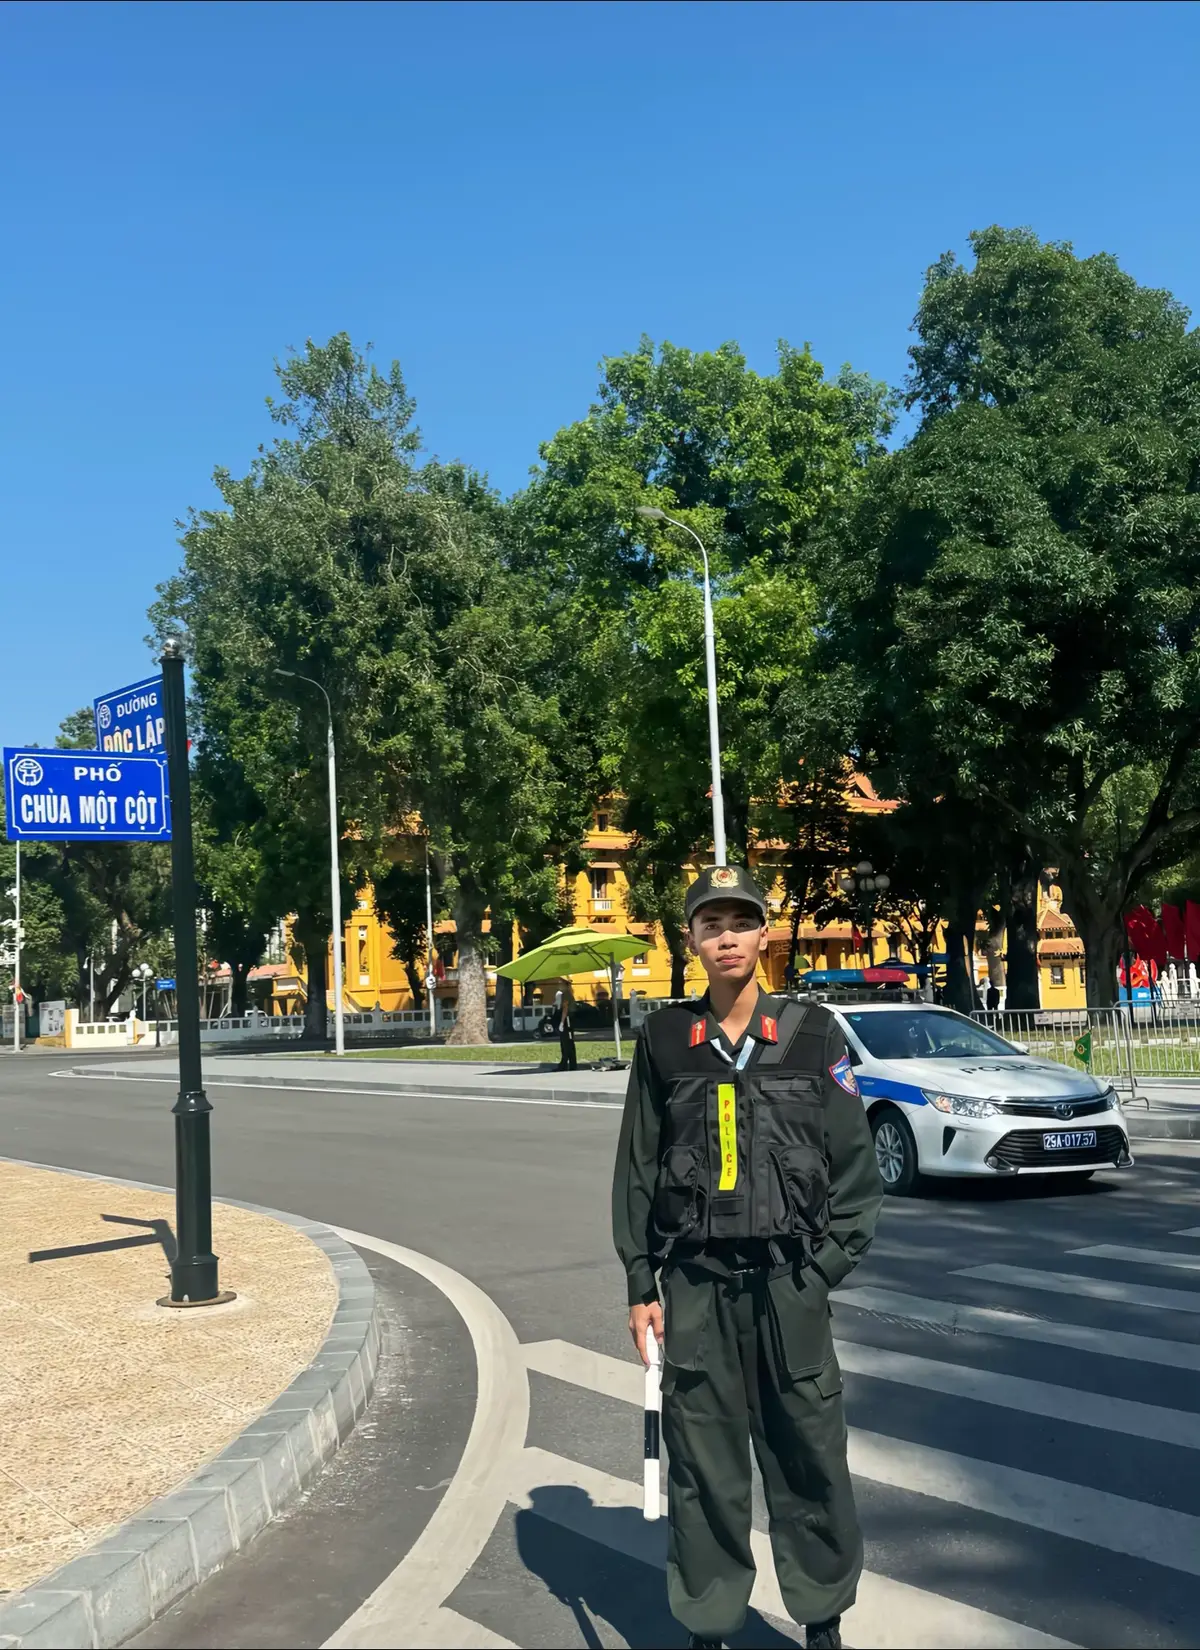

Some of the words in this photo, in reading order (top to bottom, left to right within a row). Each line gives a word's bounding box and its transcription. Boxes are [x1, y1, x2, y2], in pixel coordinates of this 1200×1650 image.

[116, 692, 157, 718] ĐƯỜNG
[135, 714, 165, 754] LẬP
[73, 761, 122, 782] PHỐ
[21, 787, 72, 824] CHÙA
[79, 789, 118, 831] MỘT
[124, 789, 157, 831] CỘT
[724, 1100, 732, 1177] POLICE
